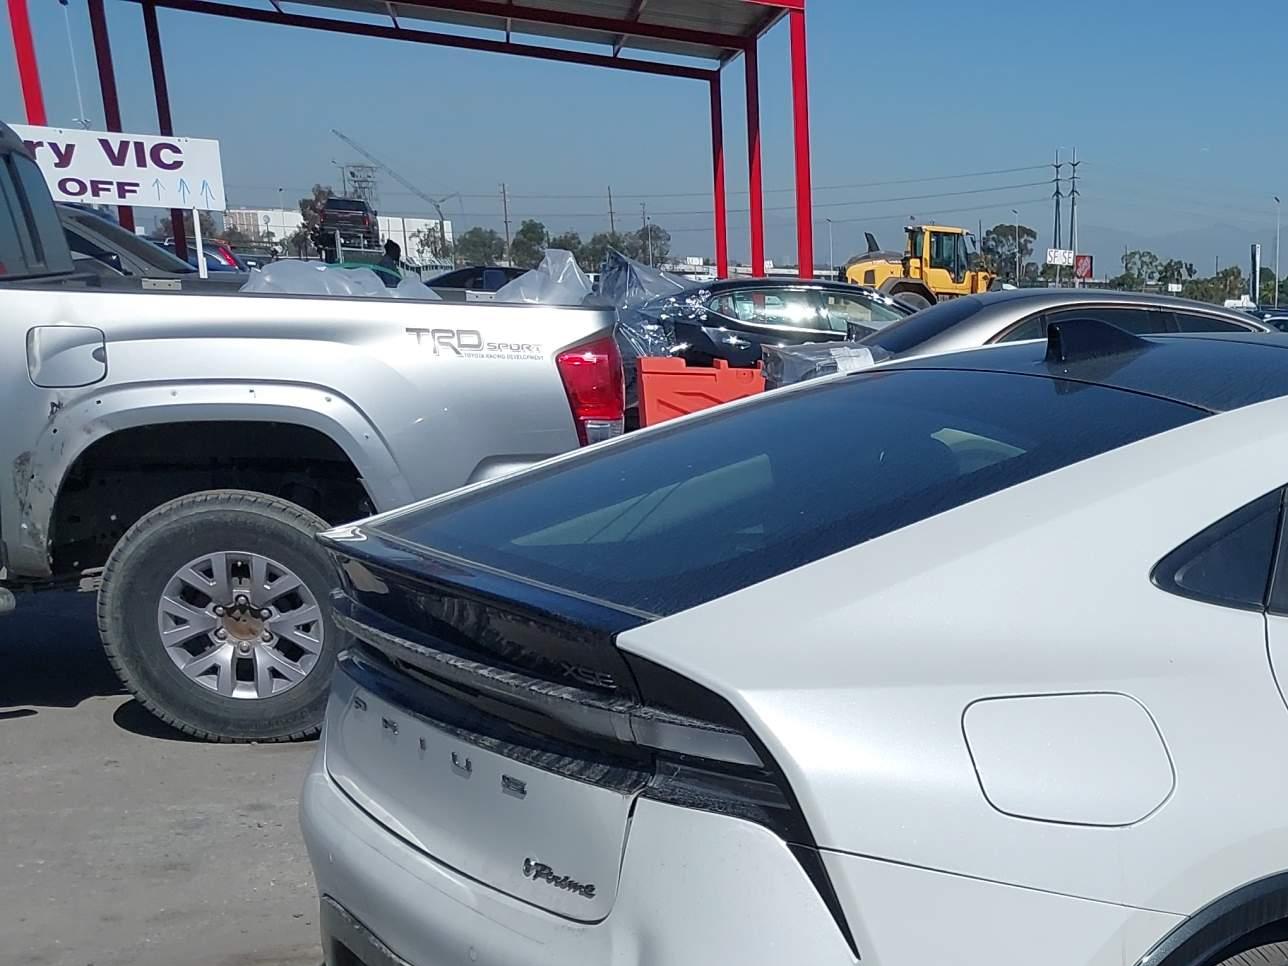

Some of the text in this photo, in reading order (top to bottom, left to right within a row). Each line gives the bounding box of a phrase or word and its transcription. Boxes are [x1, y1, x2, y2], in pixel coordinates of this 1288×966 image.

[97, 137, 185, 171] VIC
[57, 177, 141, 200] OFF
[405, 327, 544, 357] TRD SPORT
[560, 662, 618, 689] XSE
